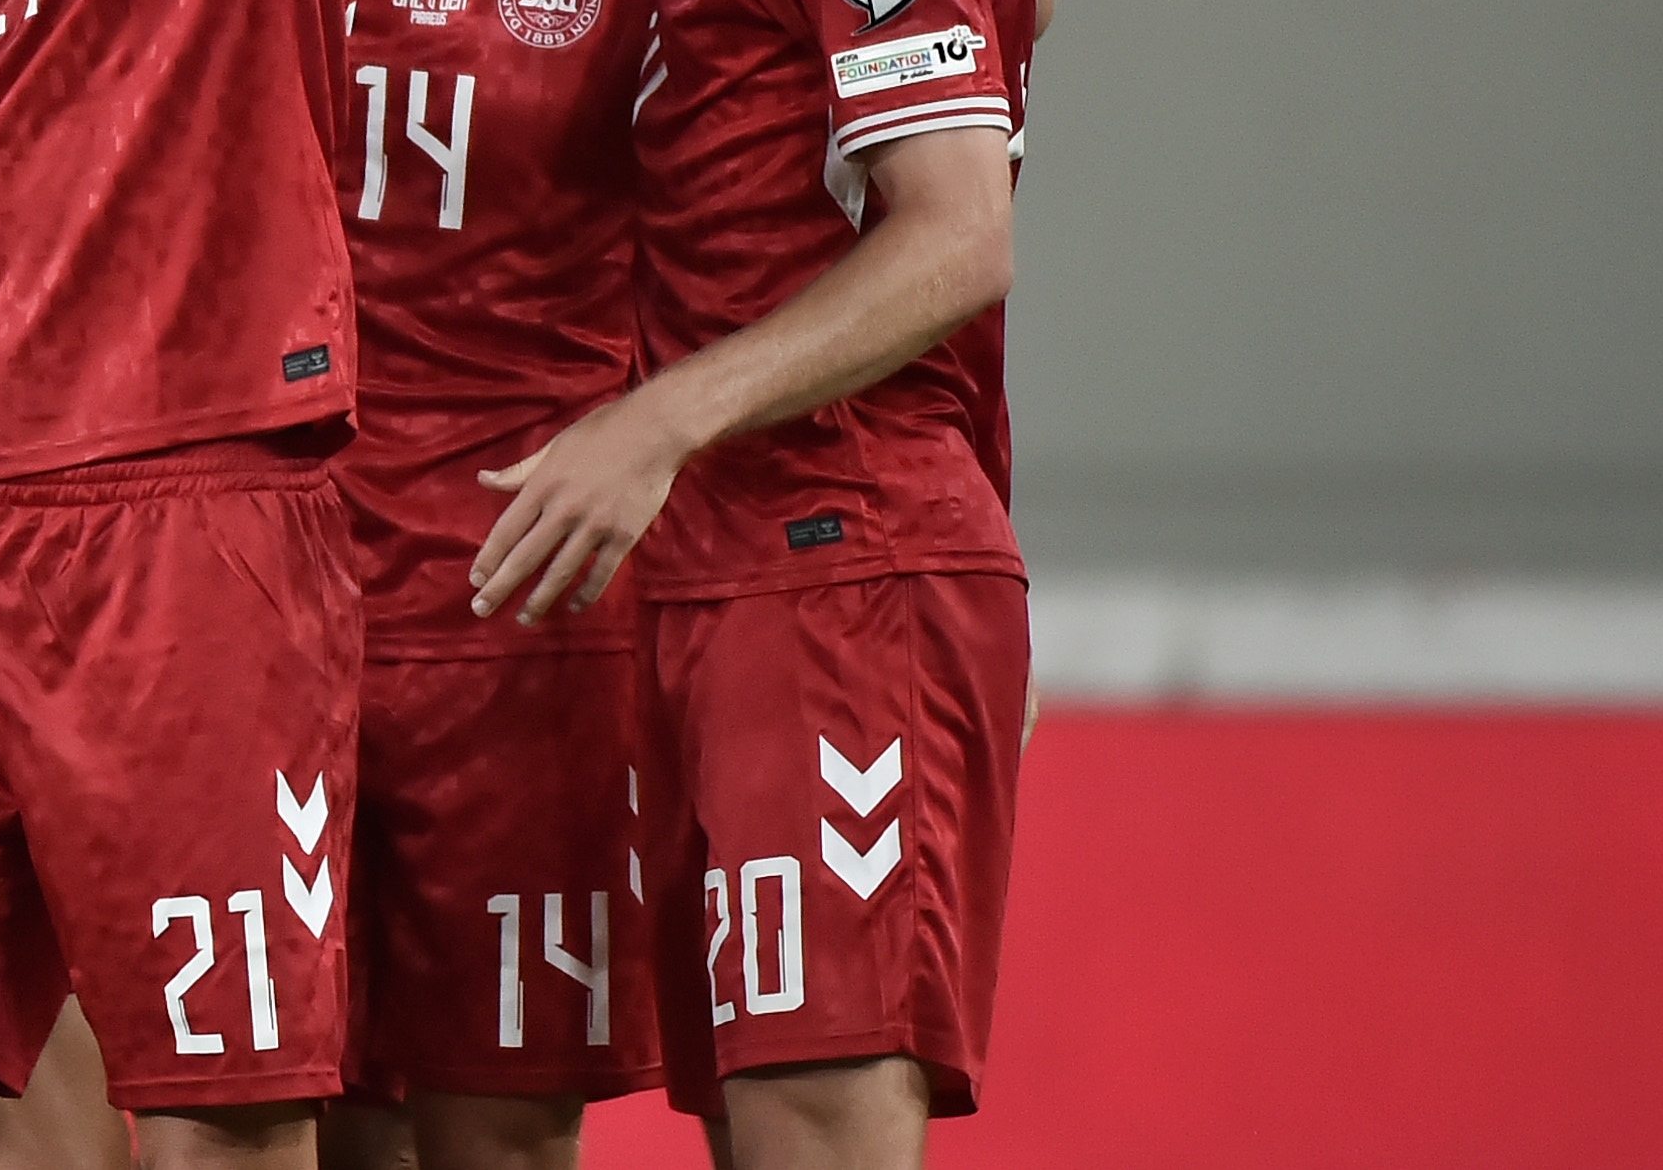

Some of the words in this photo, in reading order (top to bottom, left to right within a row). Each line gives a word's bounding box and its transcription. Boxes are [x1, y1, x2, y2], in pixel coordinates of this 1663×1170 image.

[524, 30, 565, 45] 1889
[836, 53, 859, 65] UEFA
[838, 51, 932, 81] FOUNDATION
[932, 38, 968, 64] 10
[356, 65, 475, 229] 14
[152, 890, 278, 1054] 21
[487, 893, 609, 1047] 14
[705, 856, 804, 1026] 20
